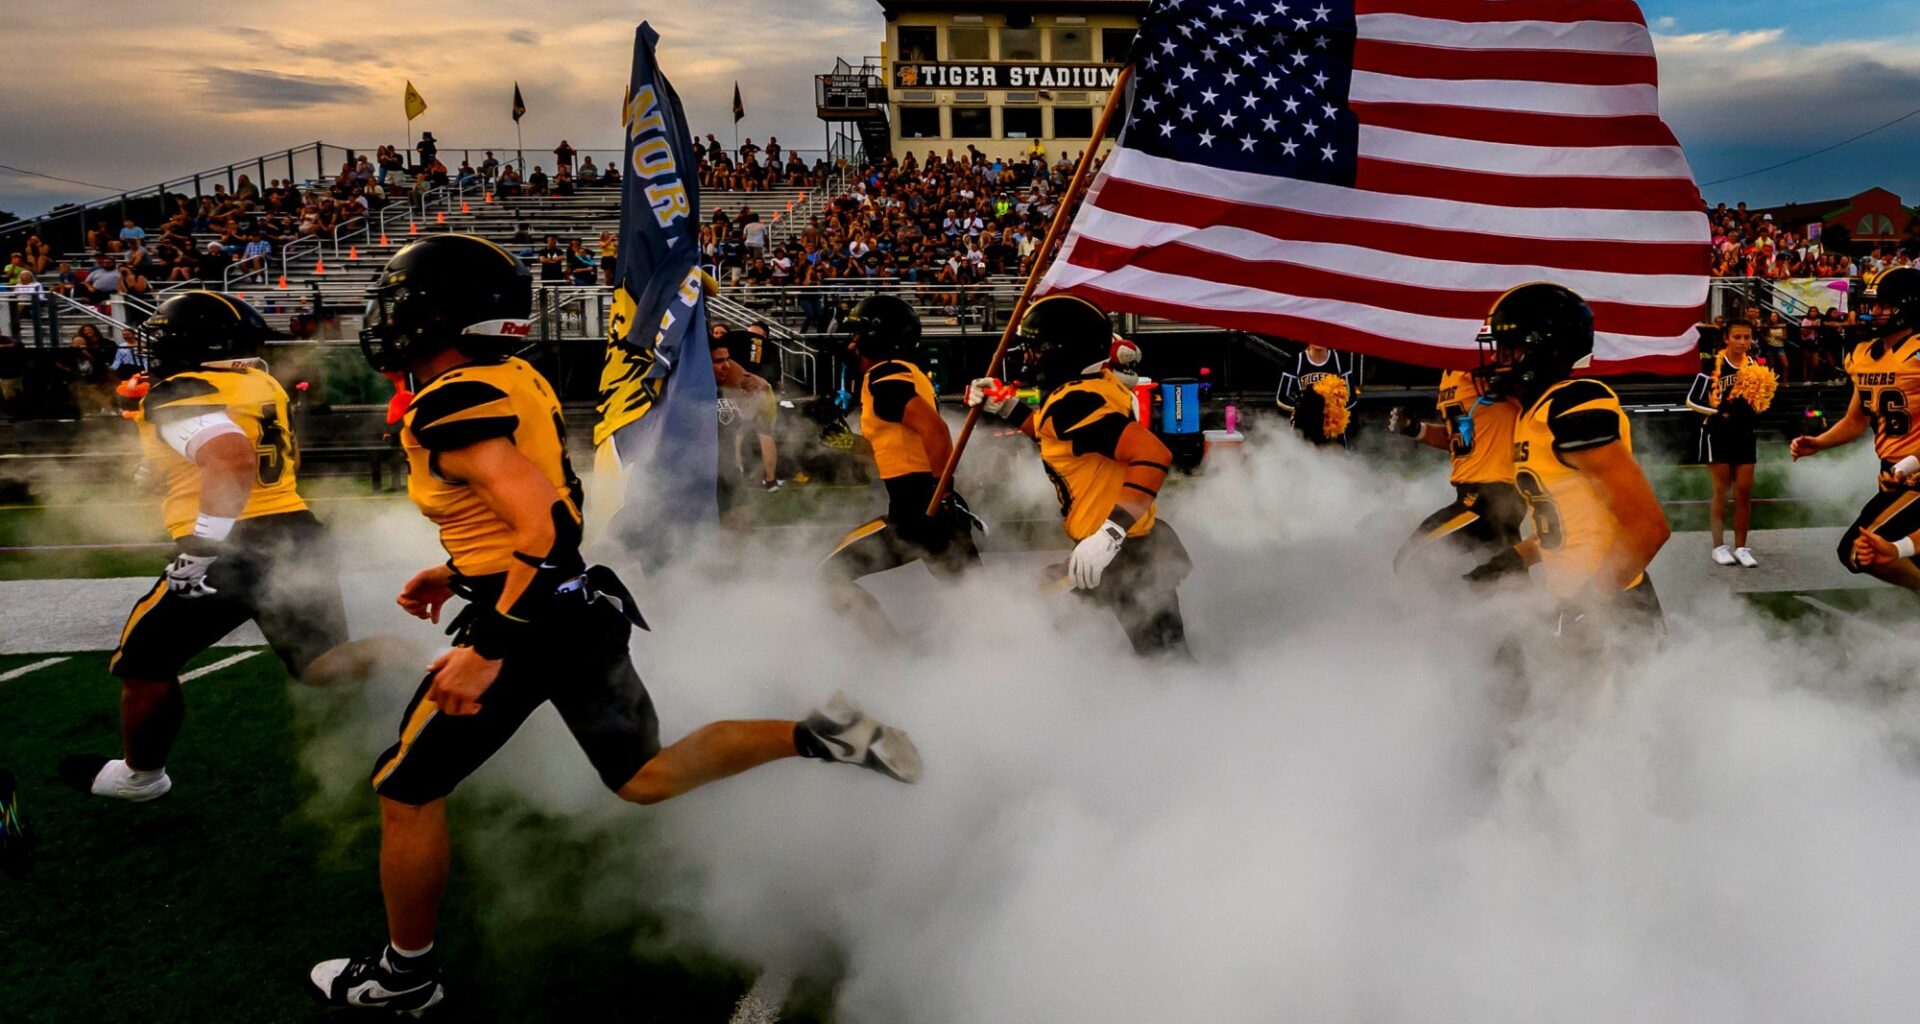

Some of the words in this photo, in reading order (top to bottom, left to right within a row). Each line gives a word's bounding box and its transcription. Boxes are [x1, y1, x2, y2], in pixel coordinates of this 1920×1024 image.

[921, 66, 997, 87] TIGER
[1009, 67, 1120, 88] STADIUM
[627, 83, 690, 234] NOR
[1857, 372, 1896, 385] TIGERS
[1858, 387, 1910, 438] 56
